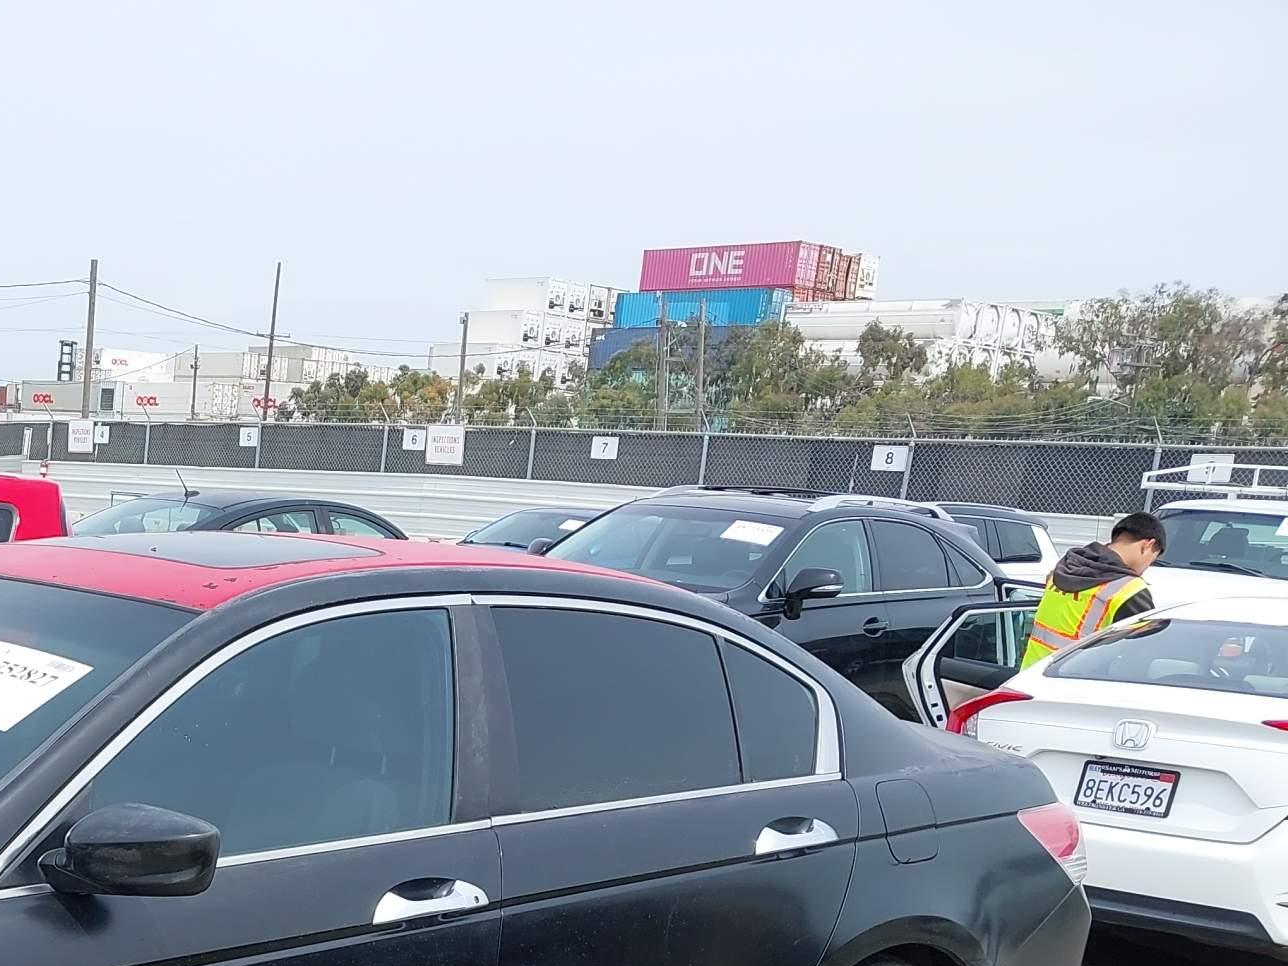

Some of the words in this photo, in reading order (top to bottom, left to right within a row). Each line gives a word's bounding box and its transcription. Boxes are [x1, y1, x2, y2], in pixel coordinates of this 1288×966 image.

[689, 250, 745, 276] ONE
[33, 393, 54, 404] OOCL
[136, 395, 159, 406] OOCL
[246, 432, 252, 442] 5
[411, 434, 418, 445] 6
[602, 442, 609, 453] 7
[885, 451, 895, 464] 8
[1083, 778, 1167, 808] 8EKC596
